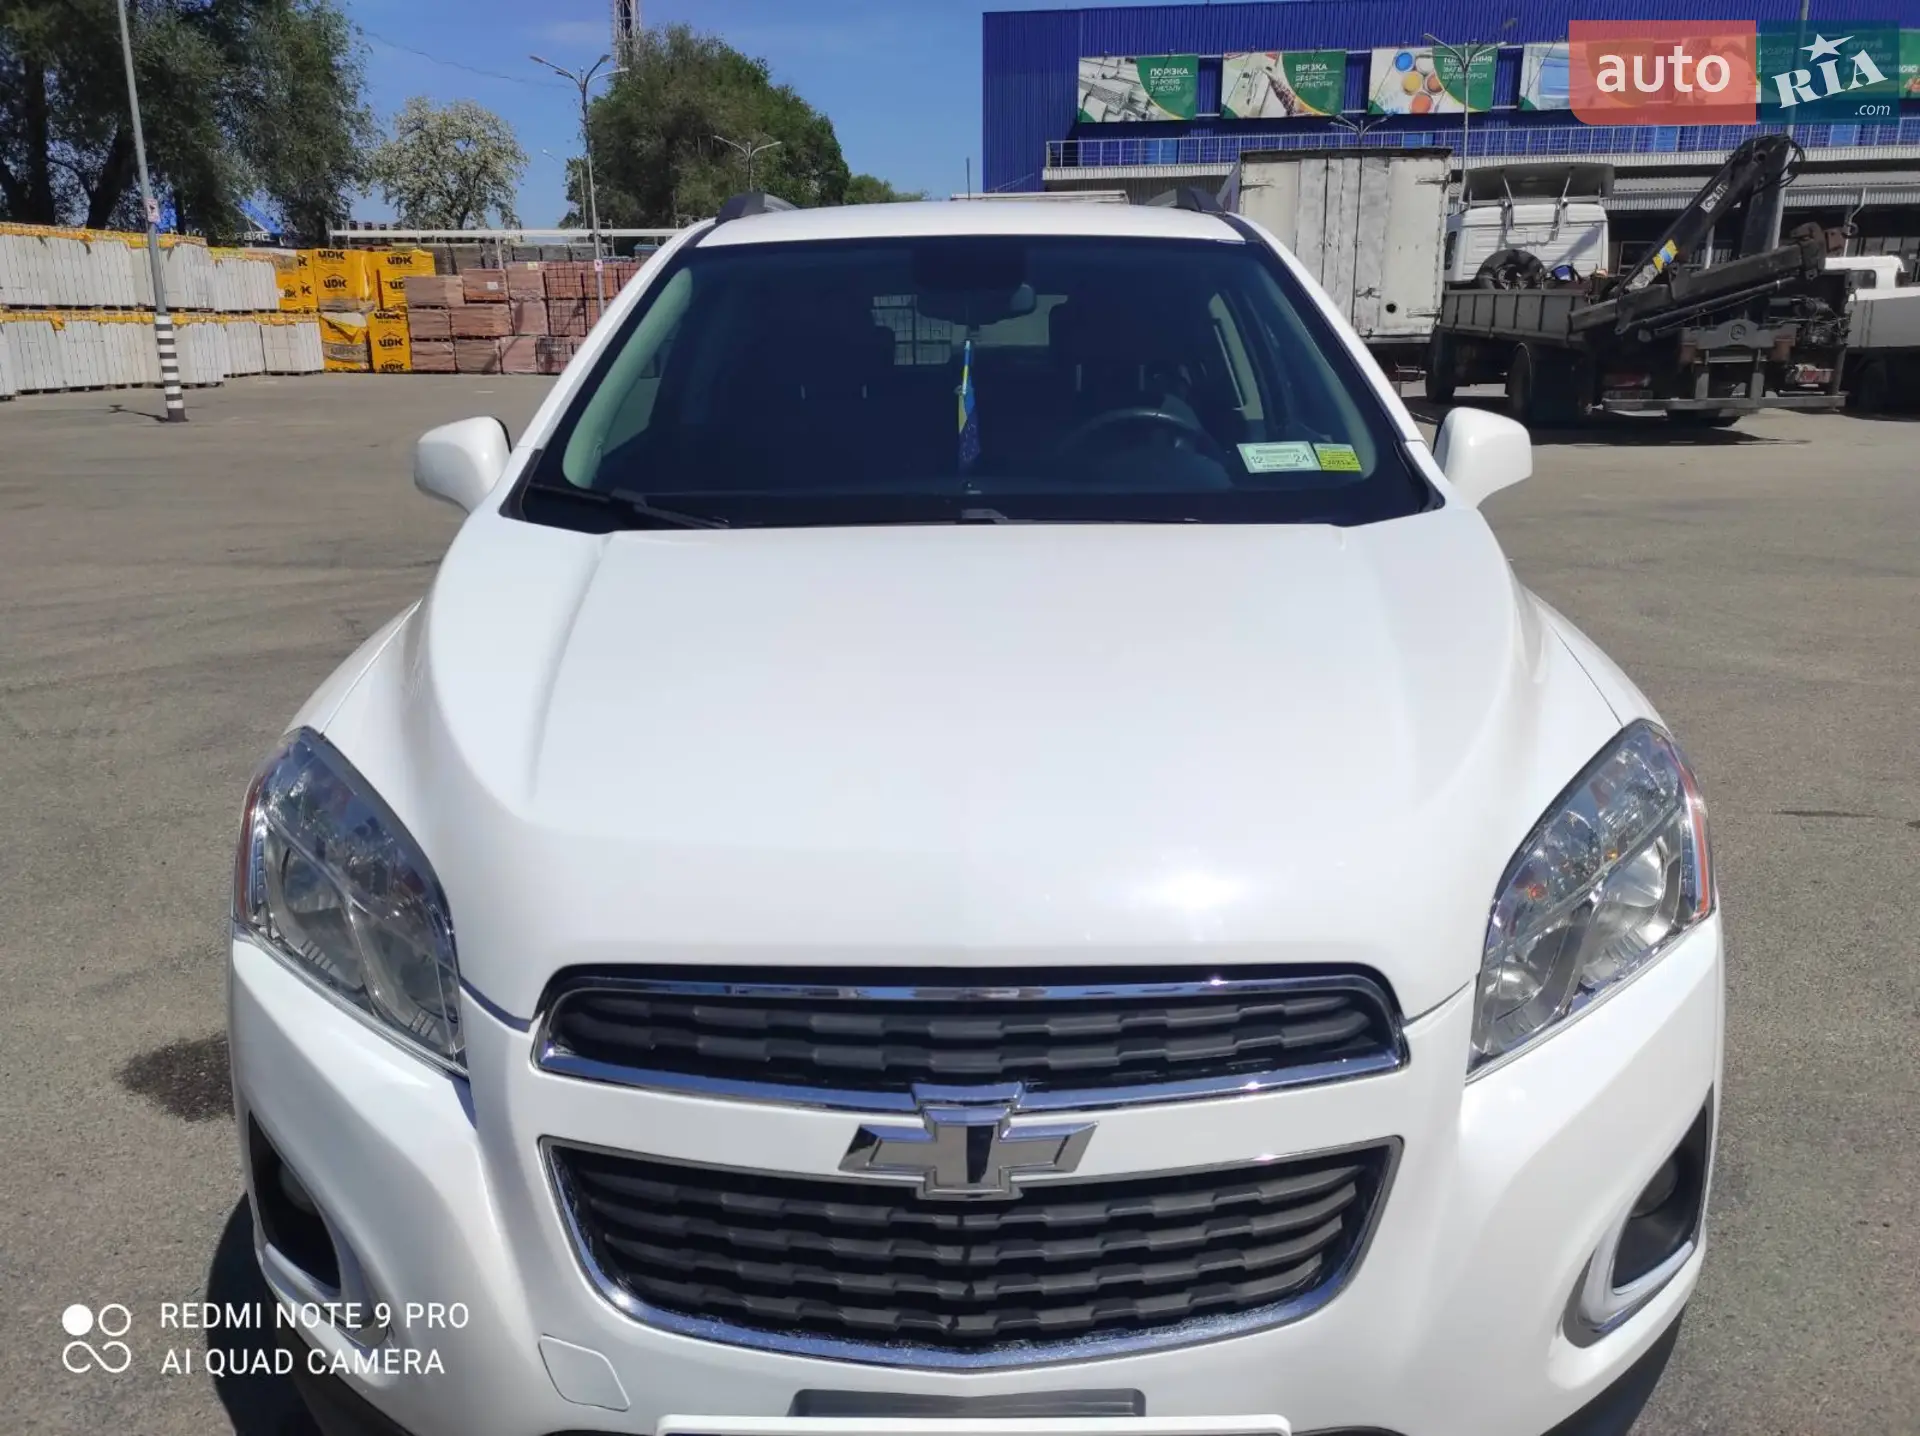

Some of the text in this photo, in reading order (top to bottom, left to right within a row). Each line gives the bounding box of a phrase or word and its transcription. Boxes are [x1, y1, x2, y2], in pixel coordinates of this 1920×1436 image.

[1150, 67, 1189, 76] ПОРІЗКА
[1295, 63, 1328, 71] ВРІЗКА
[318, 250, 346, 261] UDK
[387, 255, 413, 265] UDK
[323, 279, 348, 289] UDK
[389, 280, 404, 290] UD
[378, 338, 404, 348] UDK
